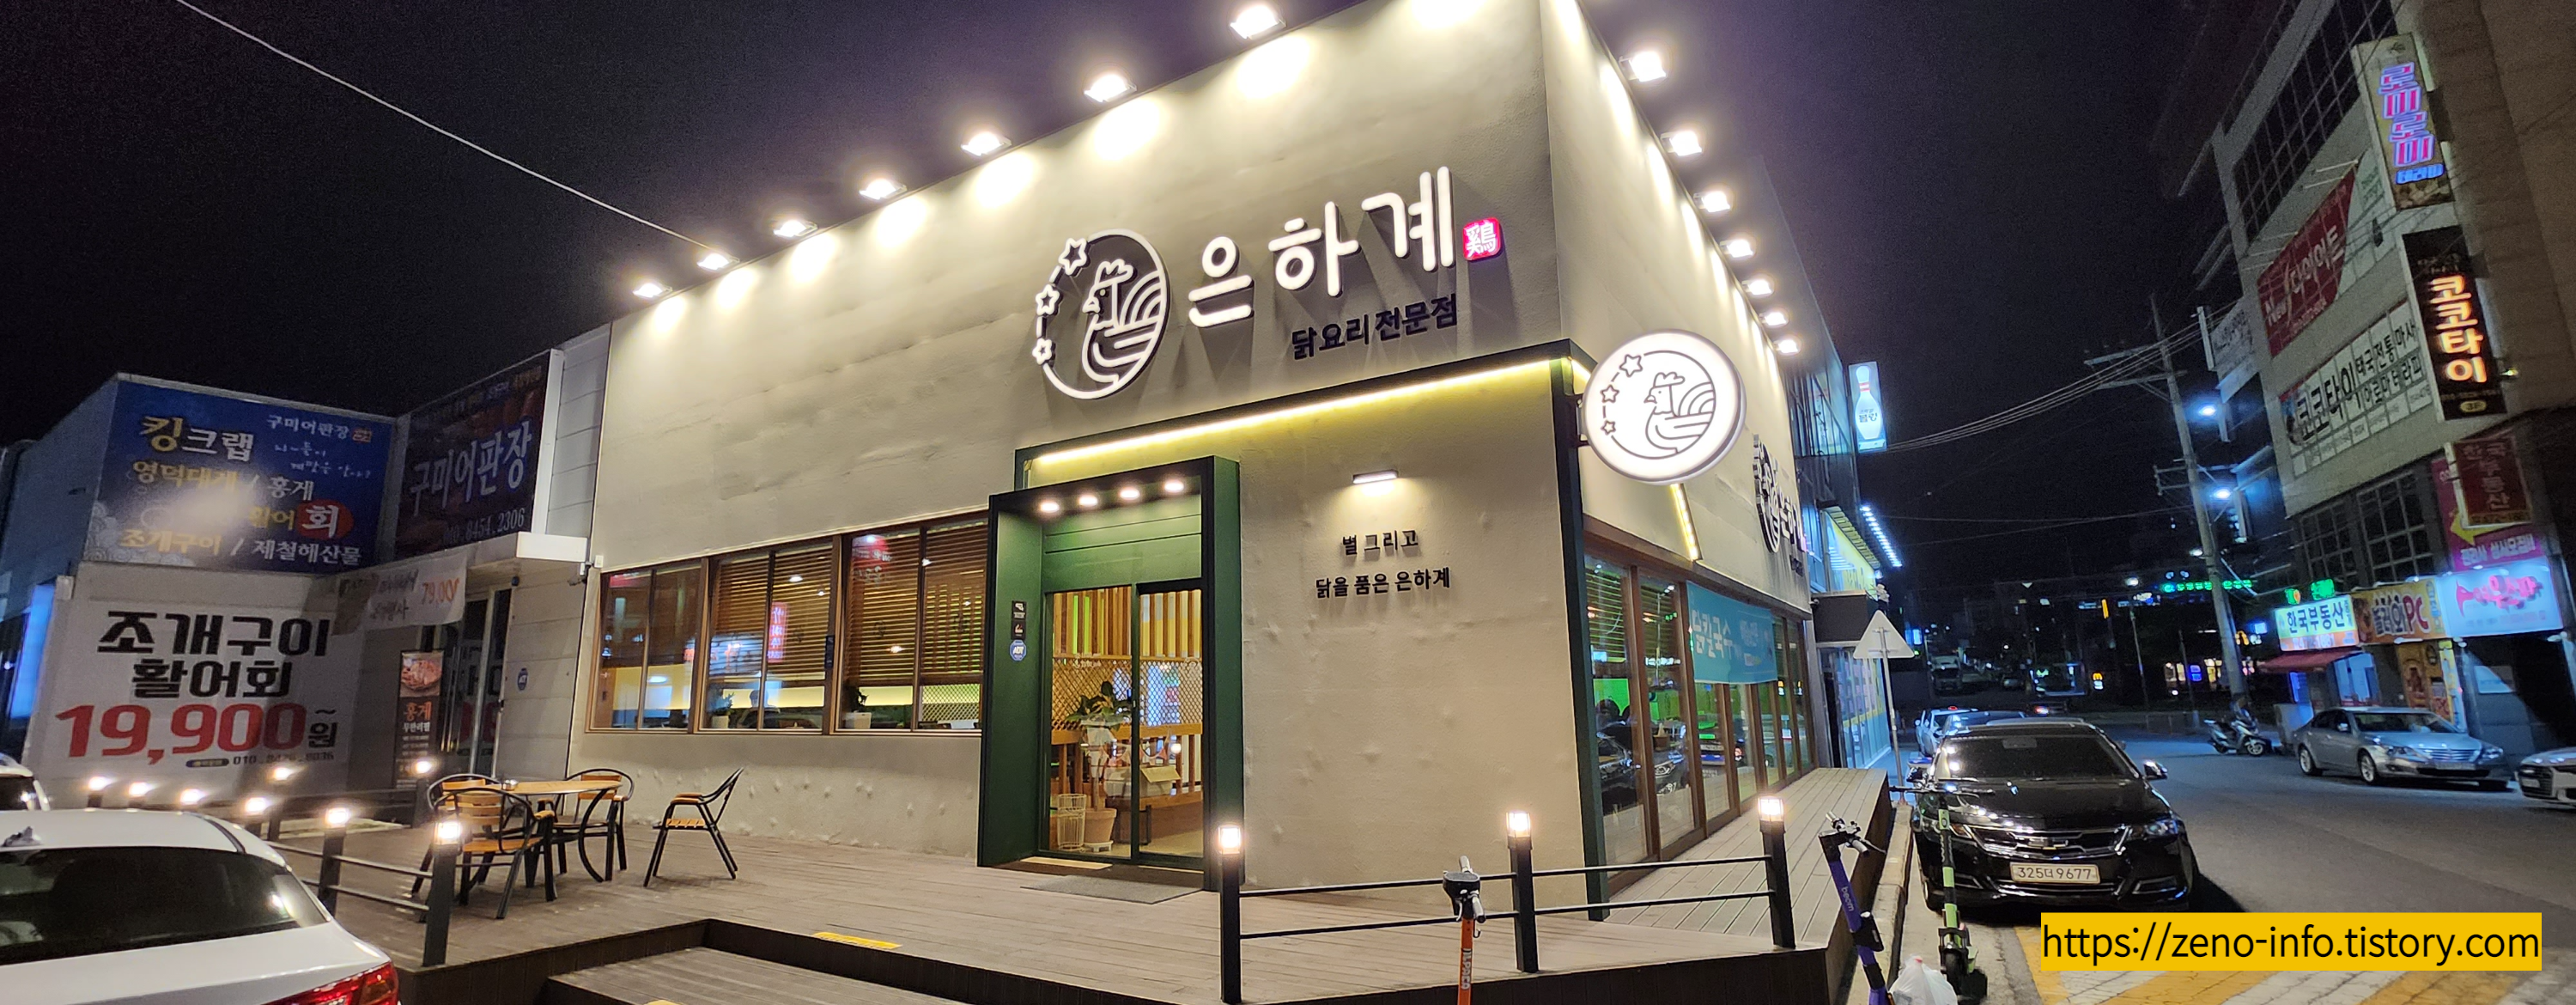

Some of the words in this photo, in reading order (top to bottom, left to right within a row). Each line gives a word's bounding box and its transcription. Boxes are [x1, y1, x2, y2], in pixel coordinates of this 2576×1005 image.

[2378, 62, 2435, 168] 로미로미
[1188, 165, 1455, 327] 은하계
[2429, 275, 2488, 382] 코코타이
[2296, 362, 2360, 442] 코코타이
[140, 417, 254, 462] 킹크랩
[266, 415, 349, 439] 구미어판장
[132, 460, 240, 494] 영덕대게
[410, 420, 533, 517] 구미어판장
[267, 475, 315, 502] 홍게
[119, 528, 222, 555] 조개구이
[252, 539, 362, 566] 제철해산물
[1342, 534, 1358, 556] 별
[1364, 530, 1419, 551] 그리고
[1315, 576, 1349, 599] 닭을
[1354, 573, 1389, 595] 품은
[1394, 567, 1450, 592] 은하계
[97, 611, 331, 656] 조개구이
[2286, 600, 2344, 634] 한국부동산
[131, 658, 292, 698] 활어회
[404, 701, 432, 721] 홍게
[55, 703, 307, 765] 19,900
[1841, 886, 1855, 912] beam
